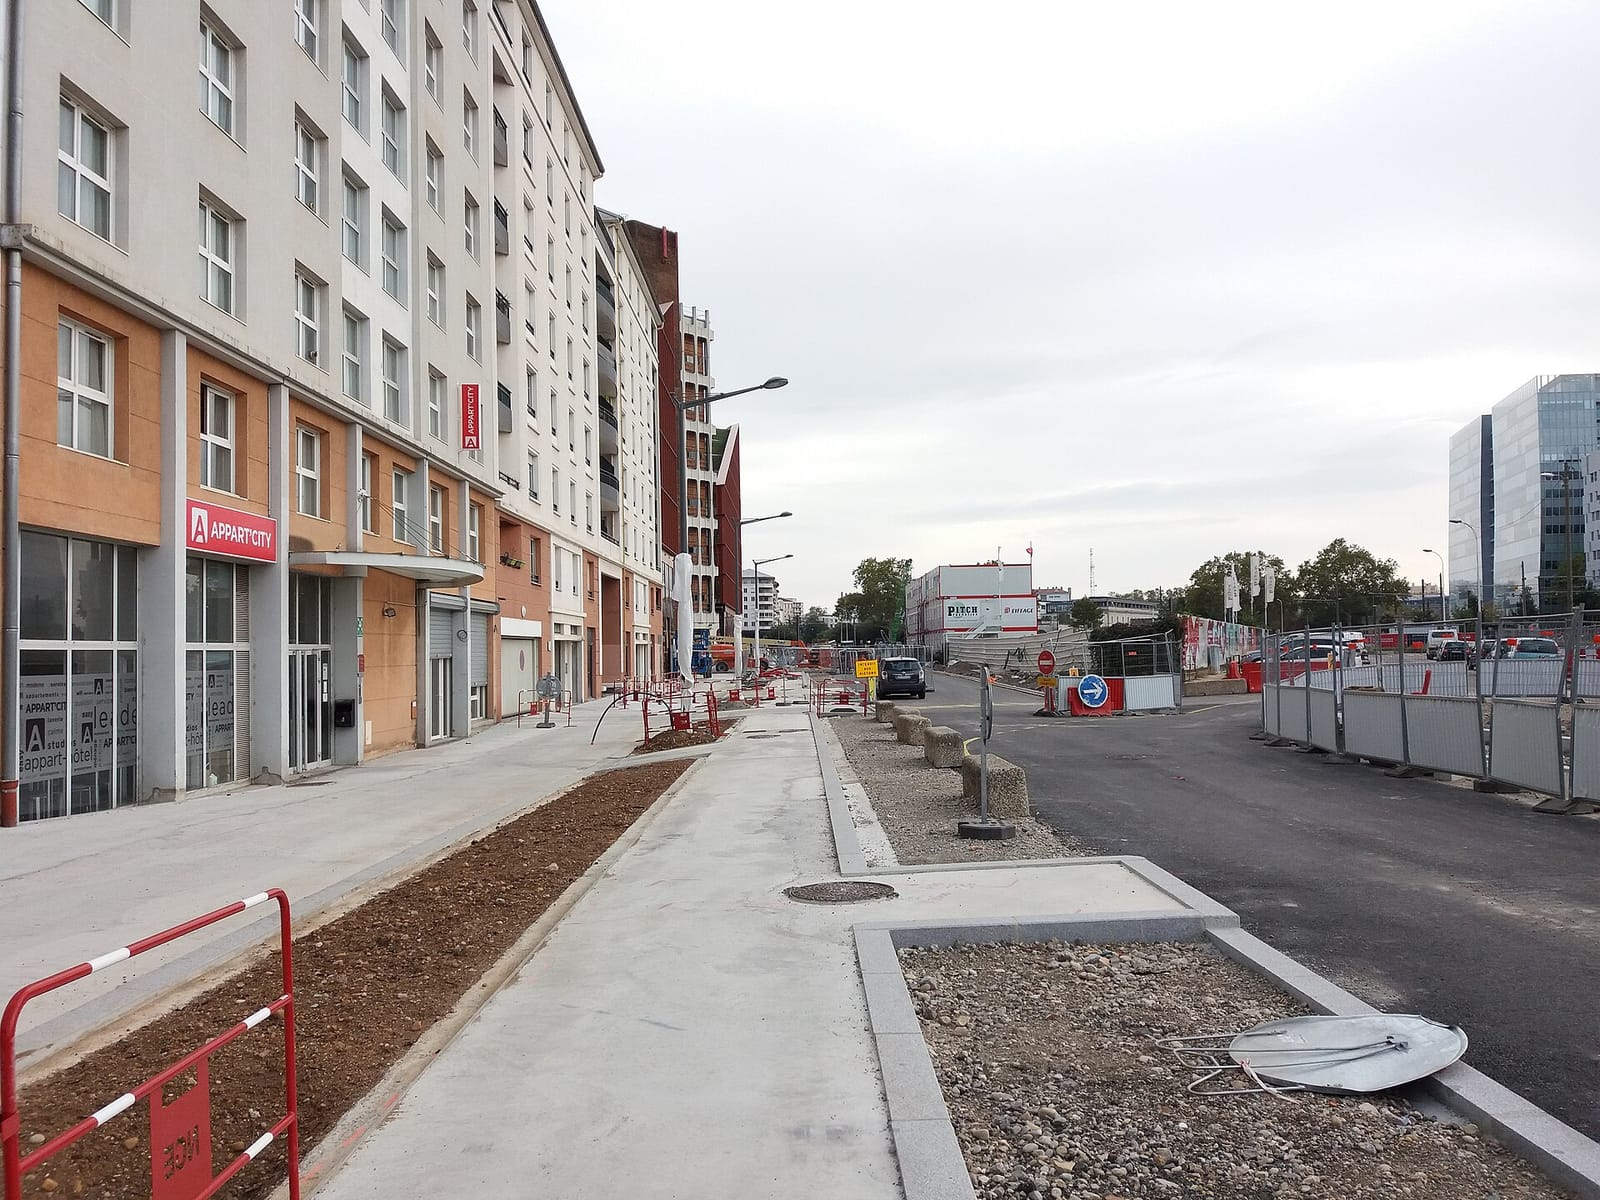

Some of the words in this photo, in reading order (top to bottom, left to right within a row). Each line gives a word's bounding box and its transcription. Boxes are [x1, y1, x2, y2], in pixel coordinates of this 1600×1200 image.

[467, 386, 475, 434] APPART'CITY
[211, 521, 272, 549] APPART'CITY
[947, 606, 978, 616] PITCH
[25, 702, 67, 713] APPART'CIT
[25, 746, 93, 772] appart-ôtel
